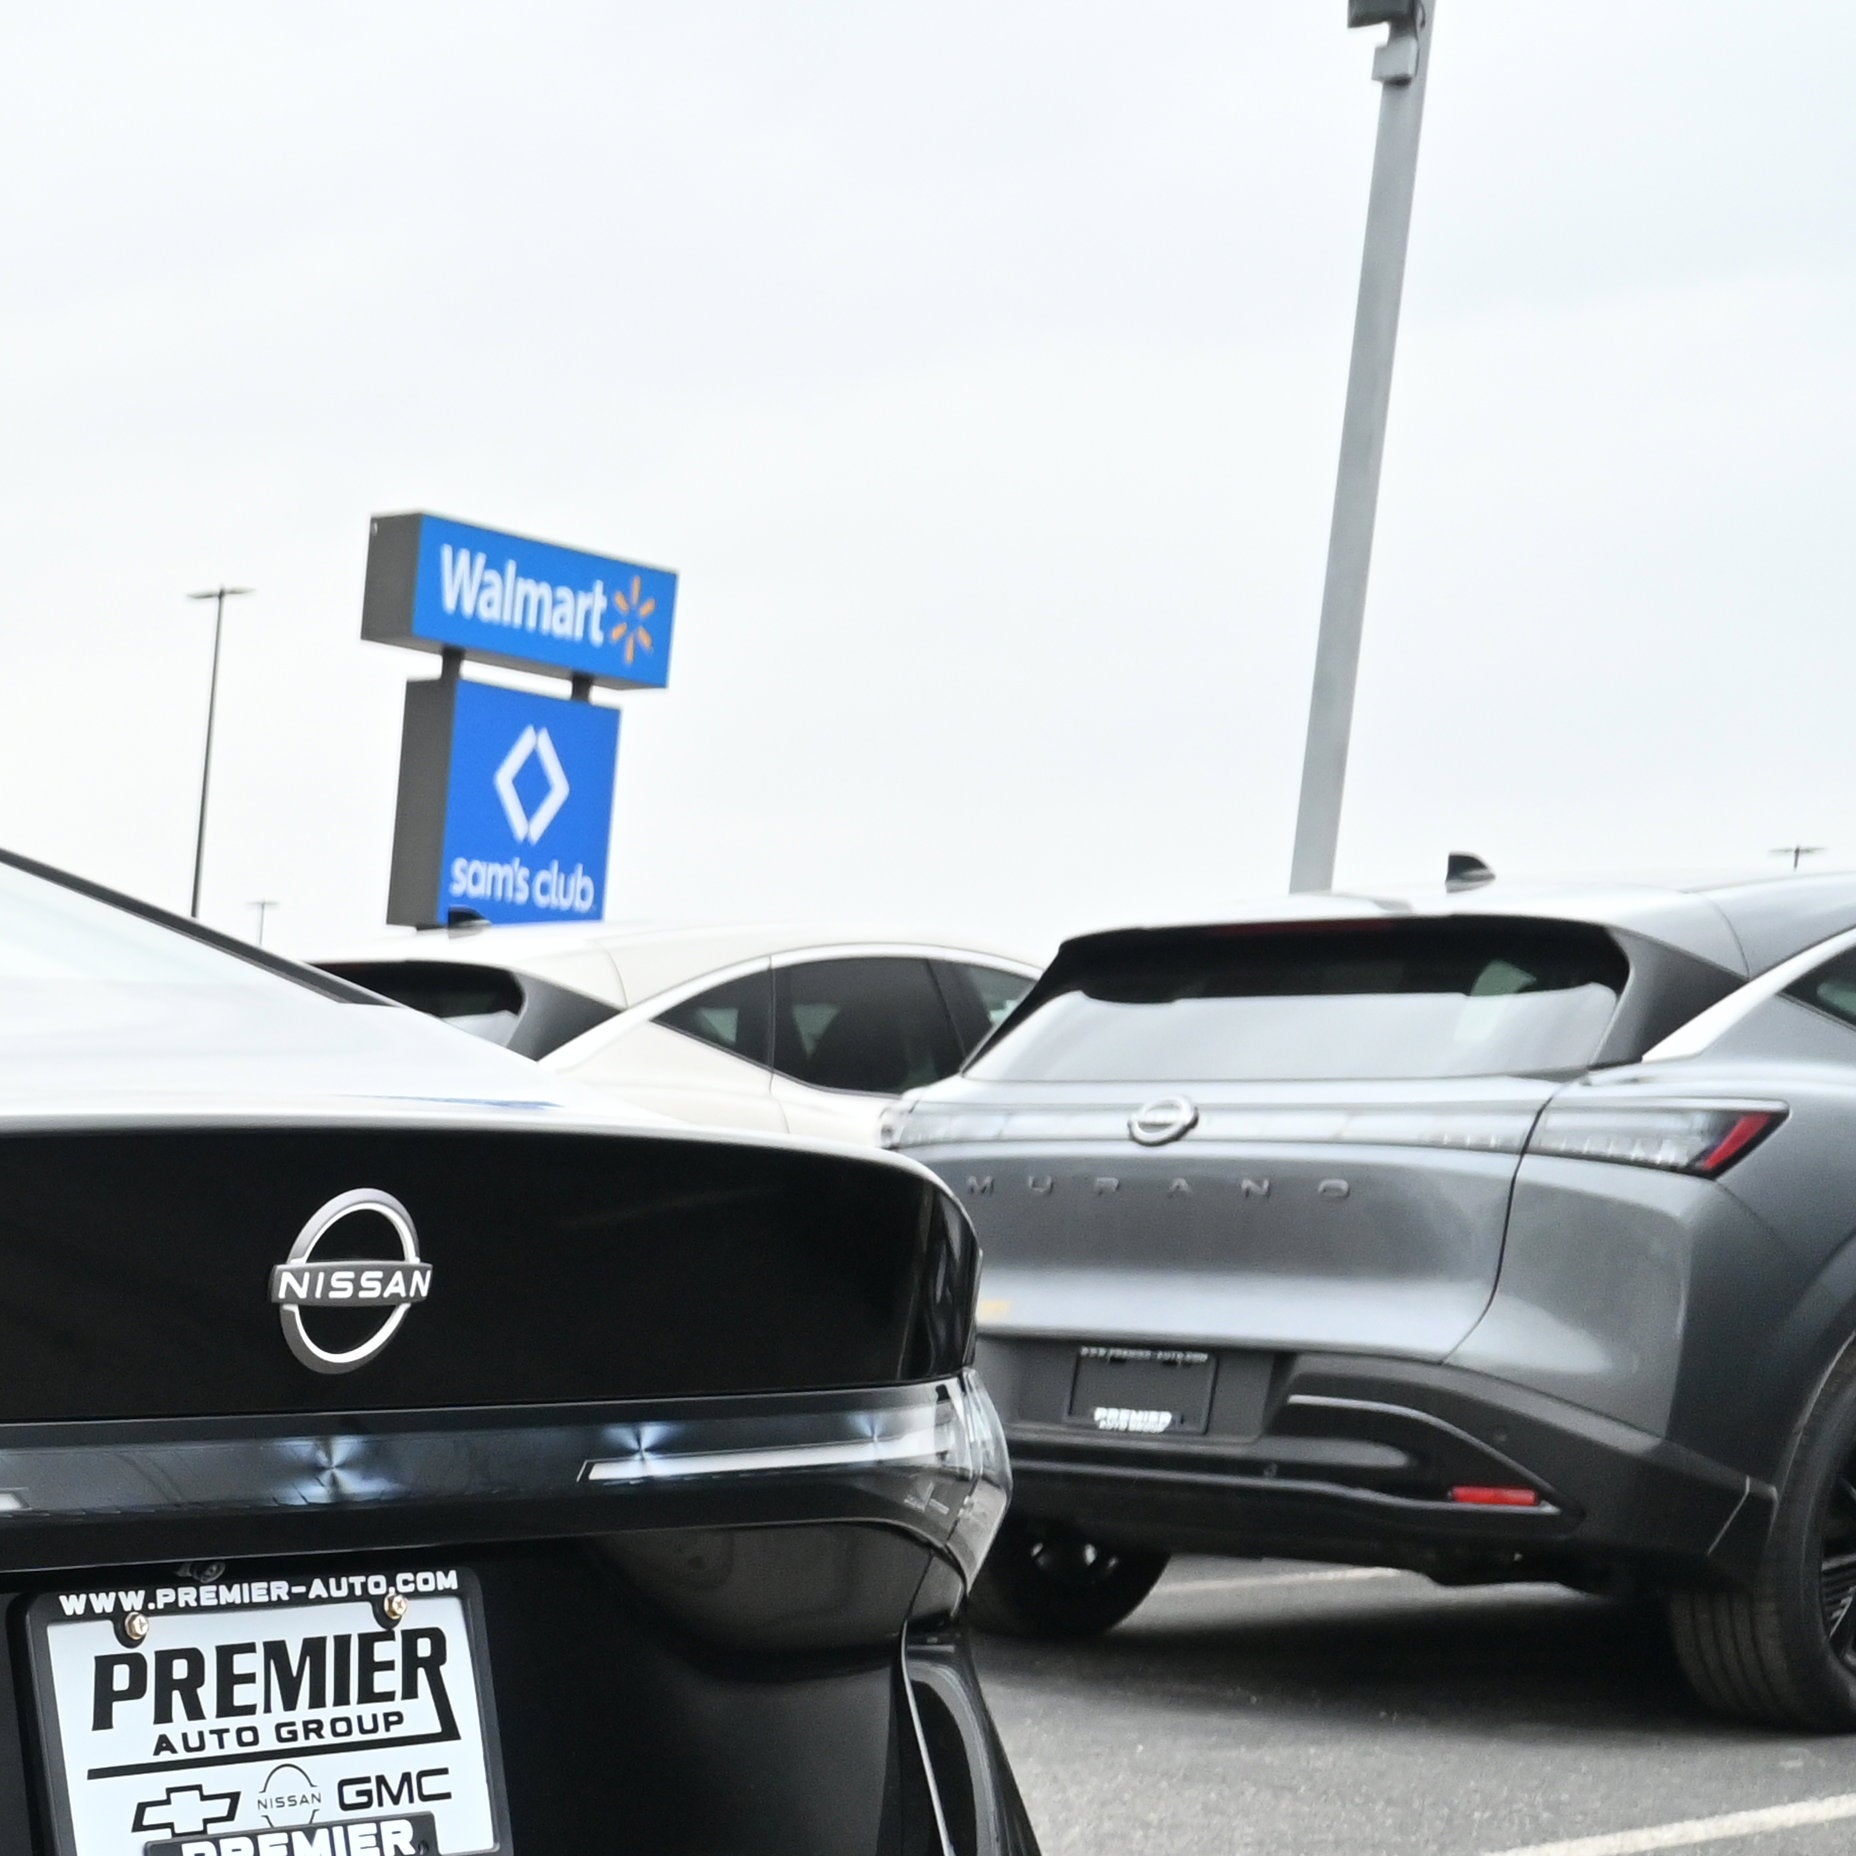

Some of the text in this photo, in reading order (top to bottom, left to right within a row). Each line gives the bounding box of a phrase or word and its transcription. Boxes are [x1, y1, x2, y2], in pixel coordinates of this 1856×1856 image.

[439, 543, 608, 647] Walmart
[450, 856, 595, 912] sam's club
[967, 1175, 1350, 1199] MURANO
[278, 1269, 432, 1300] NISSAN
[58, 1569, 458, 1616] WWW.PREMIER-AUTO.COM
[91, 1626, 461, 1741] PREMIER
[152, 1711, 405, 1757] AUTO GROUP
[256, 1791, 323, 1813] NISSAN
[336, 1767, 453, 1812] GMC
